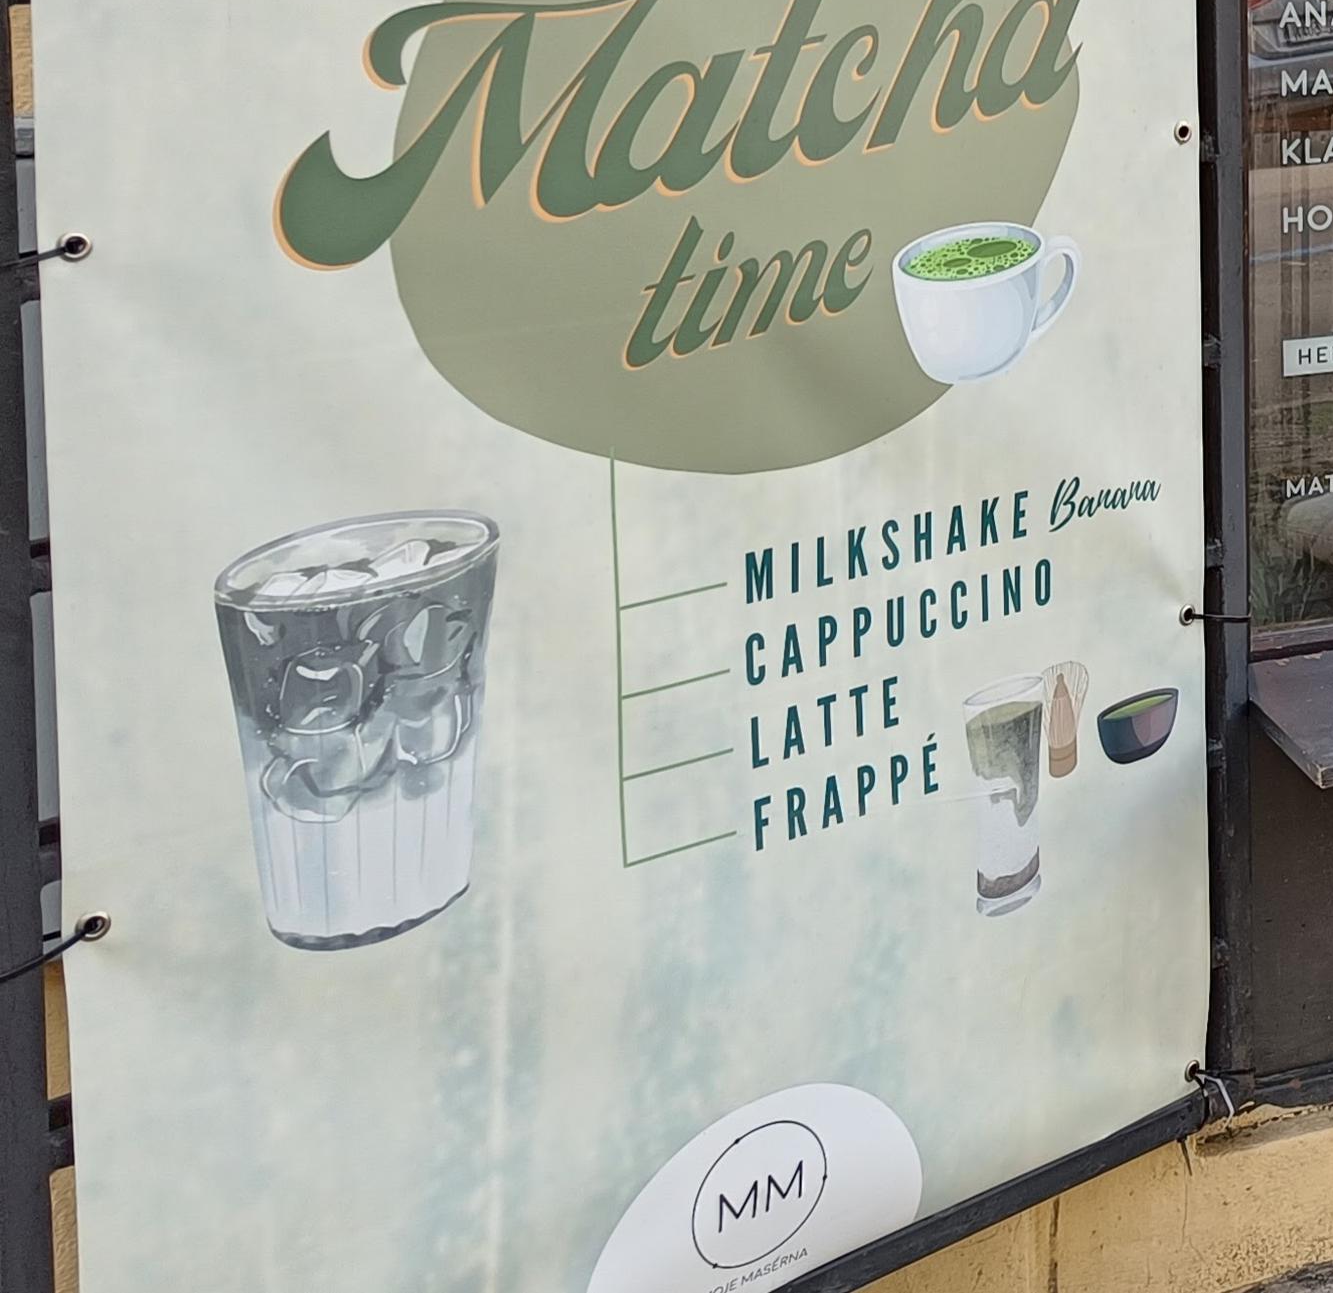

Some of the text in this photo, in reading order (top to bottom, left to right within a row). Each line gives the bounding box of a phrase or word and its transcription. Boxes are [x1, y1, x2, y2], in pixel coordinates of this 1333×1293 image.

[622, 215, 874, 371] time
[744, 475, 1161, 604] MILKSHAKE Banana
[745, 558, 1053, 687] CAPPUCCINO
[750, 676, 900, 770] LATTE
[753, 734, 940, 852] FRAPPÉ
[718, 1160, 803, 1233] MM
[740, 1247, 808, 1286] MASÉRNA
